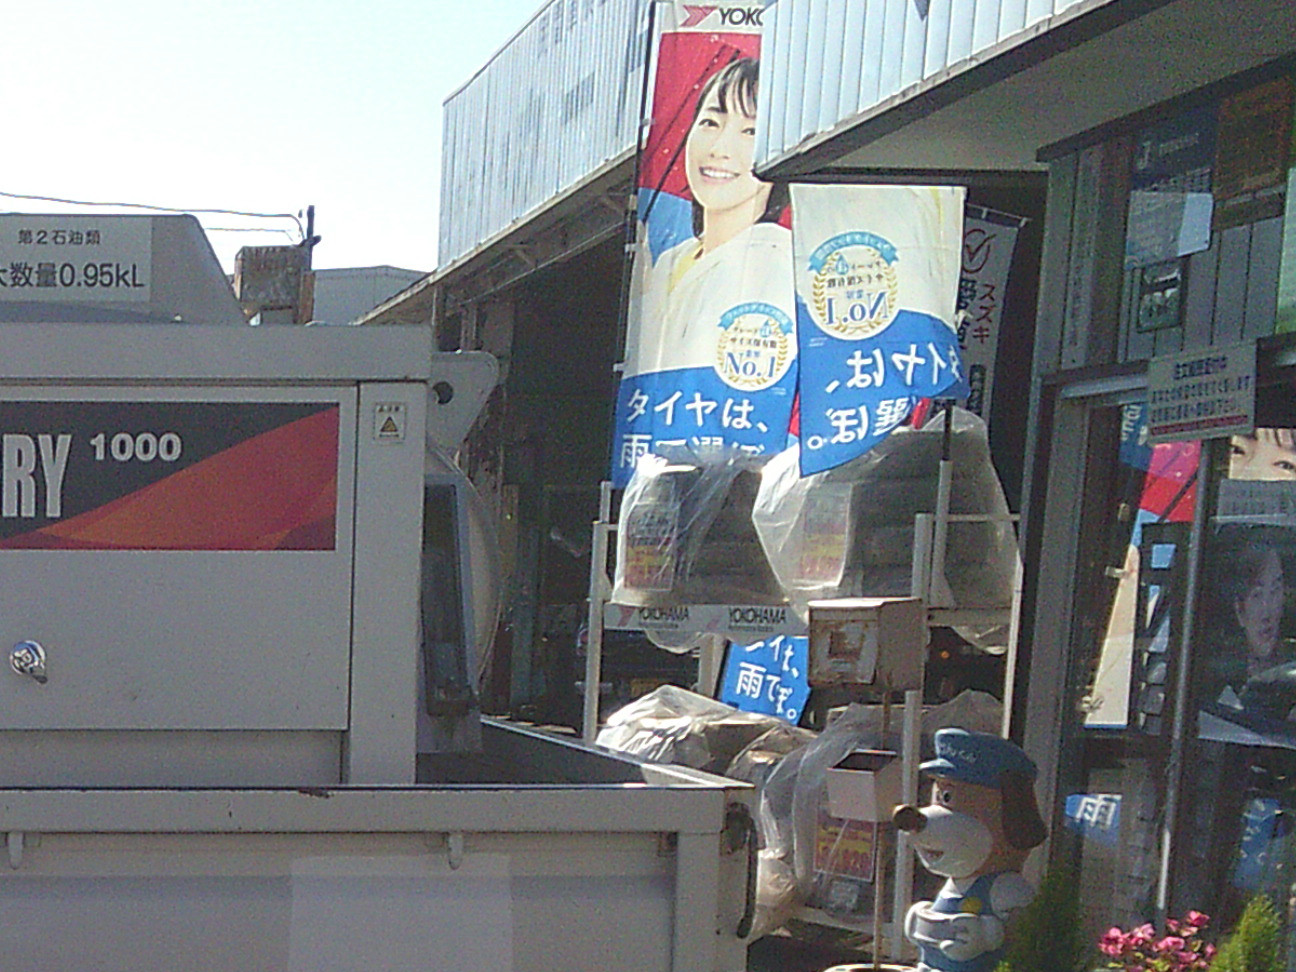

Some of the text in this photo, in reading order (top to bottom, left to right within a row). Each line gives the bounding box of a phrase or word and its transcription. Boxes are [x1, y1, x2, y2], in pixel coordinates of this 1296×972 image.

[724, 352, 776, 378] No.1
[627, 388, 769, 433] タイヤは、
[89, 432, 183, 462] 1000
